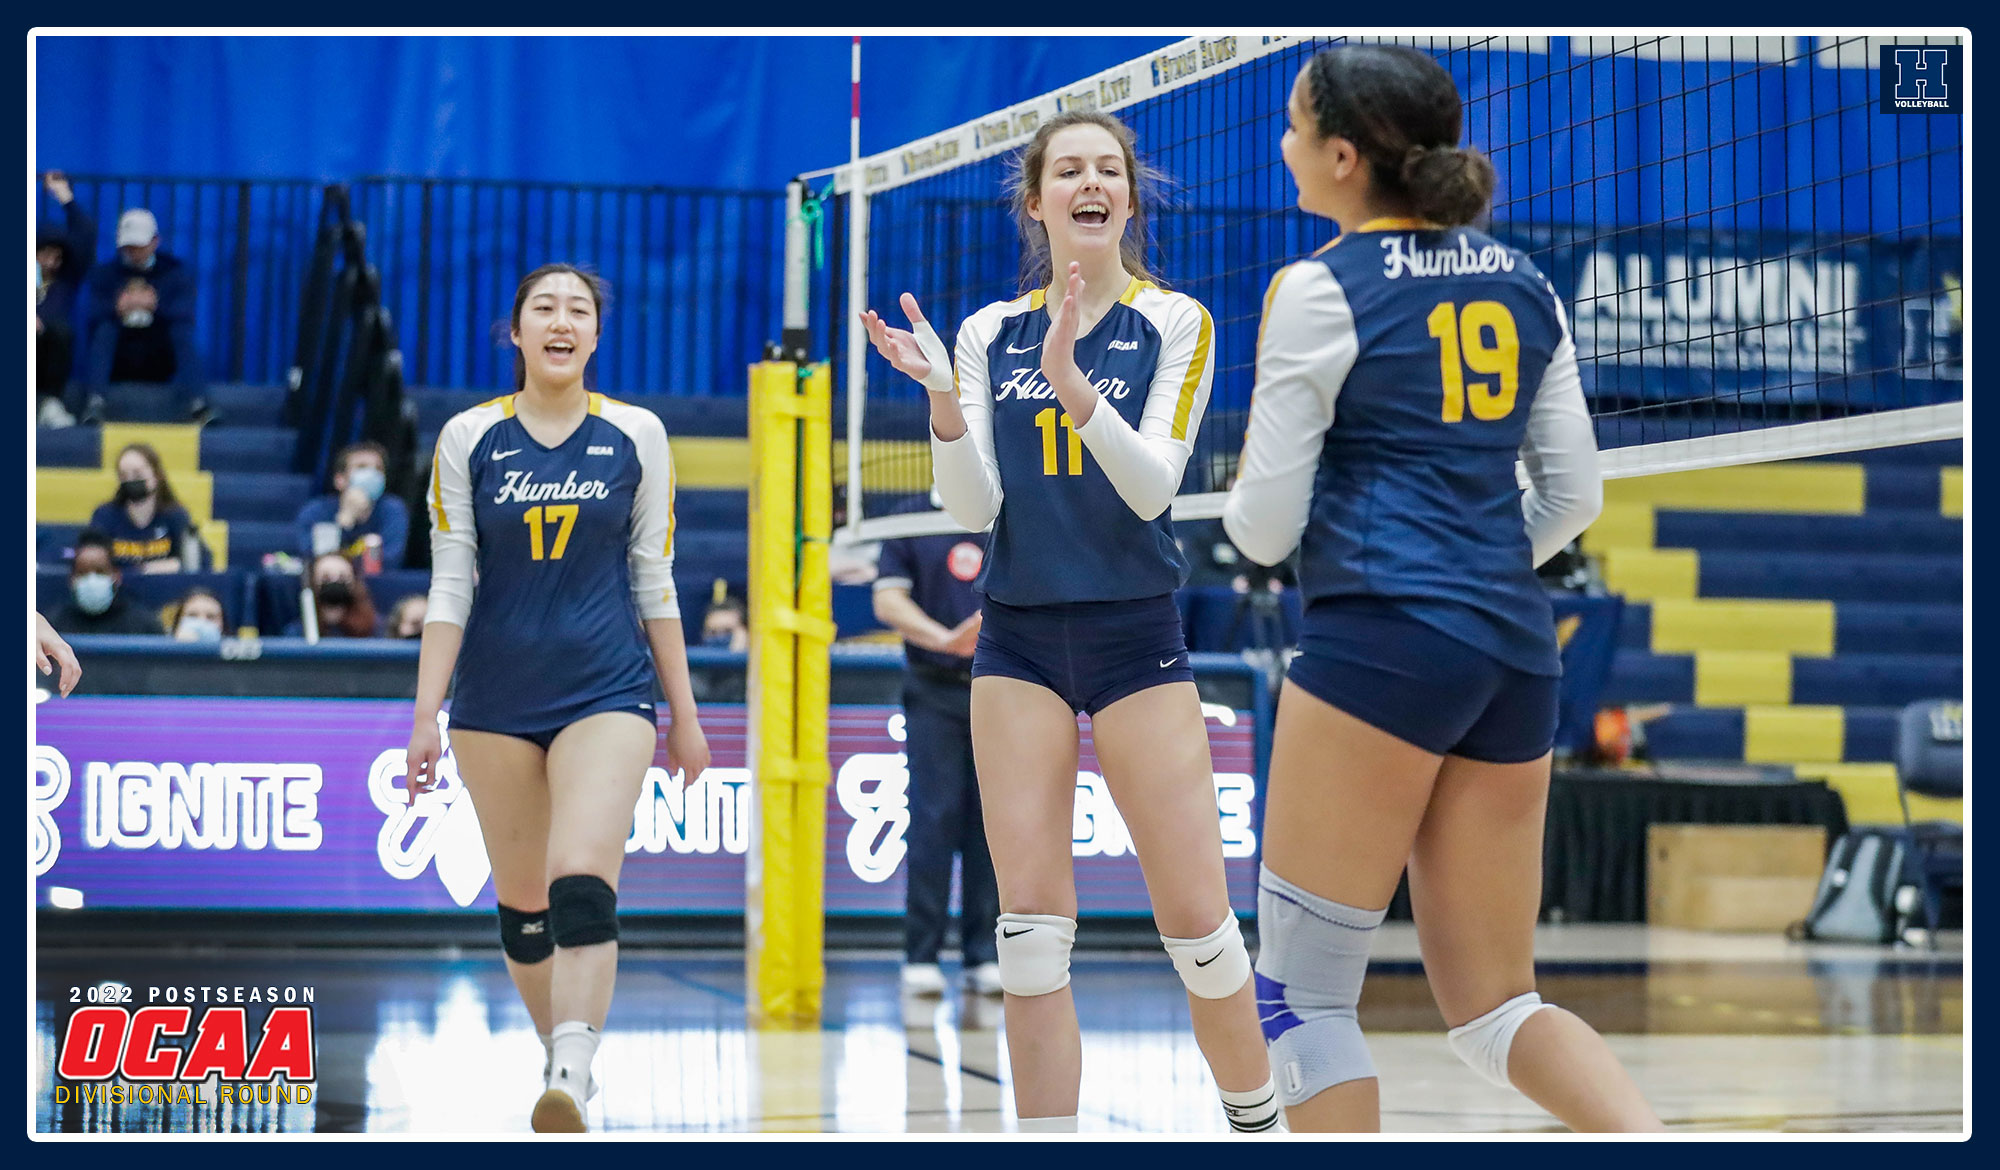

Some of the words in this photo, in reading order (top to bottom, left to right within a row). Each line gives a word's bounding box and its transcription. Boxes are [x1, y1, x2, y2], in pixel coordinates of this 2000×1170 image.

[1380, 233, 1515, 280] Humber
[1574, 251, 1861, 326] ALUMNI
[1107, 339, 1139, 351] OCAA
[1427, 300, 1520, 424] 19
[1034, 407, 1083, 476] 11
[494, 470, 610, 505] Humber
[523, 504, 580, 561] 17
[86, 761, 323, 851] IGNITE
